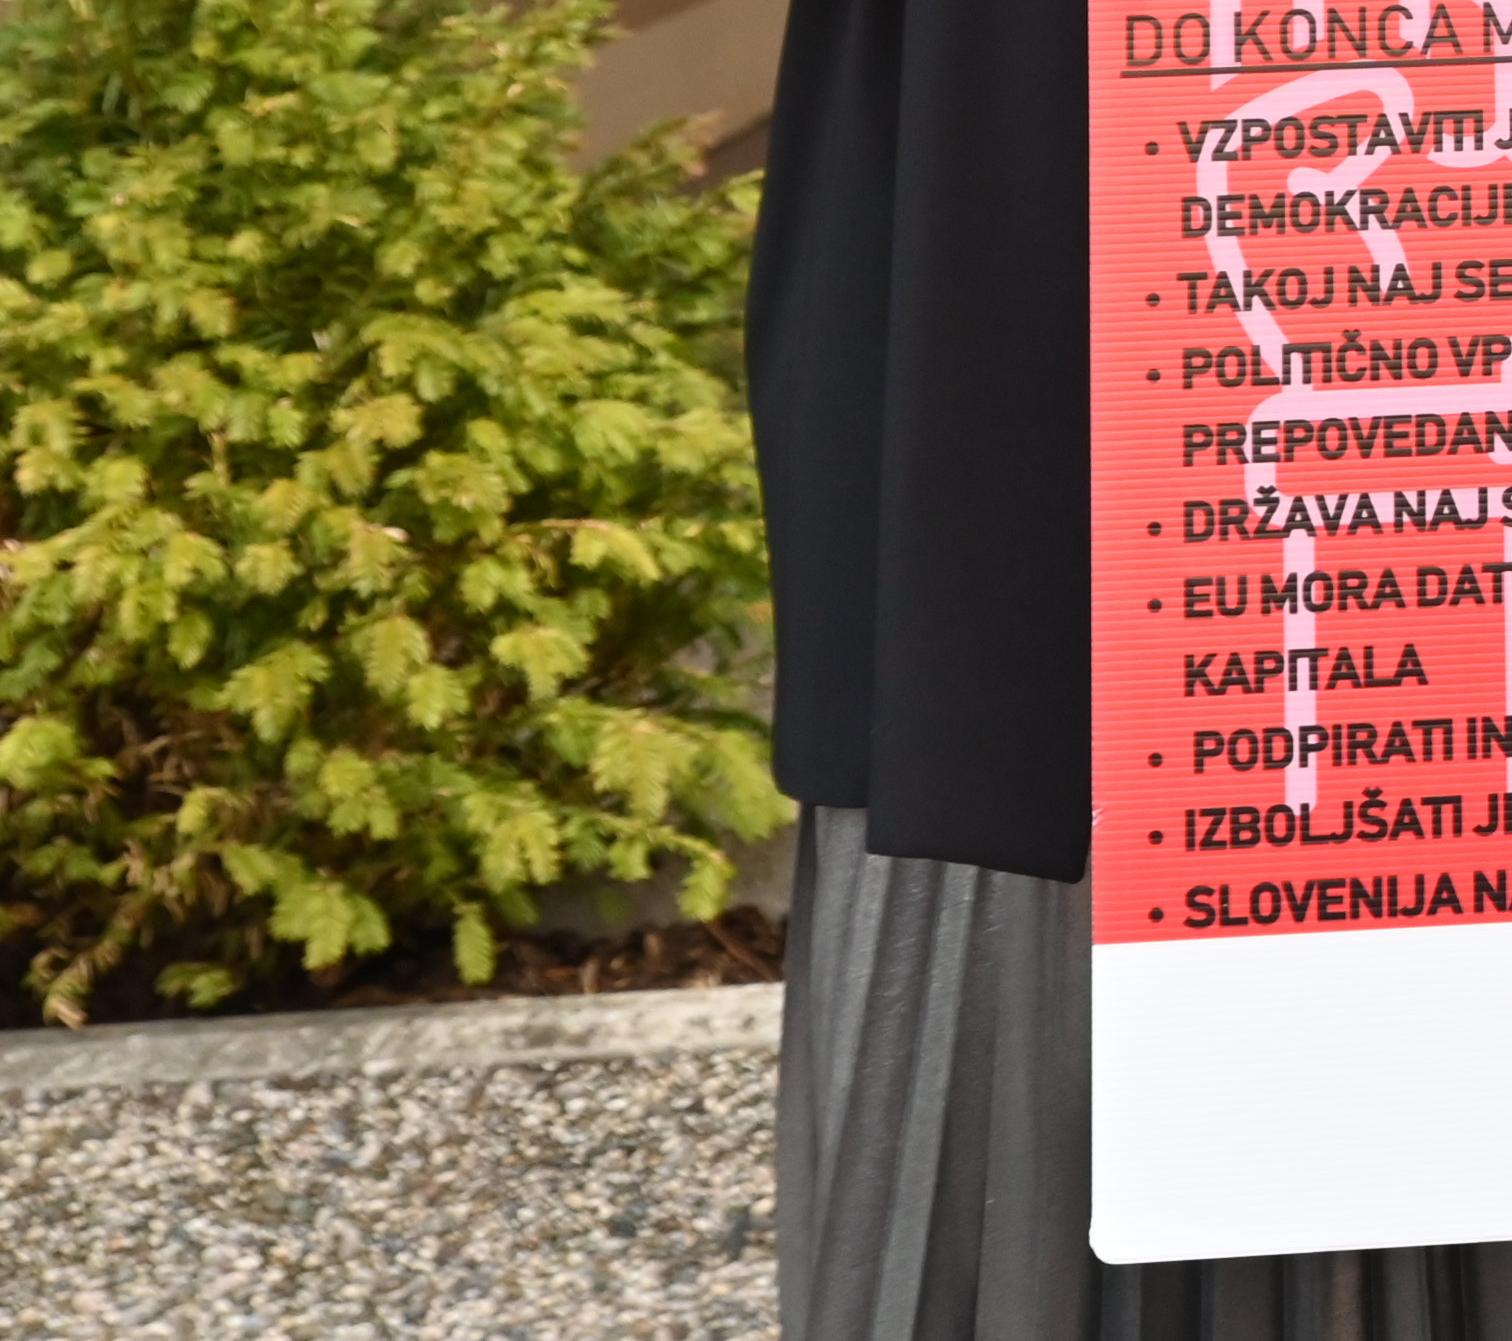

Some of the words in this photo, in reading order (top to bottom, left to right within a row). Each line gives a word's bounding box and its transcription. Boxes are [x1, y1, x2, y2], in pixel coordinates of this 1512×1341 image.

[1127, 13, 1210, 66] DO
[1234, 1, 1463, 65] KONCA
[1179, 110, 1484, 162] VZPOSTAVITI
[1178, 267, 1334, 312] TAKOJ
[1349, 263, 1442, 306] NAJ
[1184, 330, 1438, 389] POLITIČNO
[1185, 486, 1382, 542] DRŽAVA
[1394, 487, 1488, 532] NAJ
[1185, 576, 1247, 618] EU
[1262, 569, 1406, 614] MORA
[1186, 644, 1428, 696] KAPITALA
[1195, 719, 1453, 773] PODPIRATI
[1186, 789, 1462, 850] IZBOLJŠATI
[1185, 873, 1463, 928] SLOVENIJA
